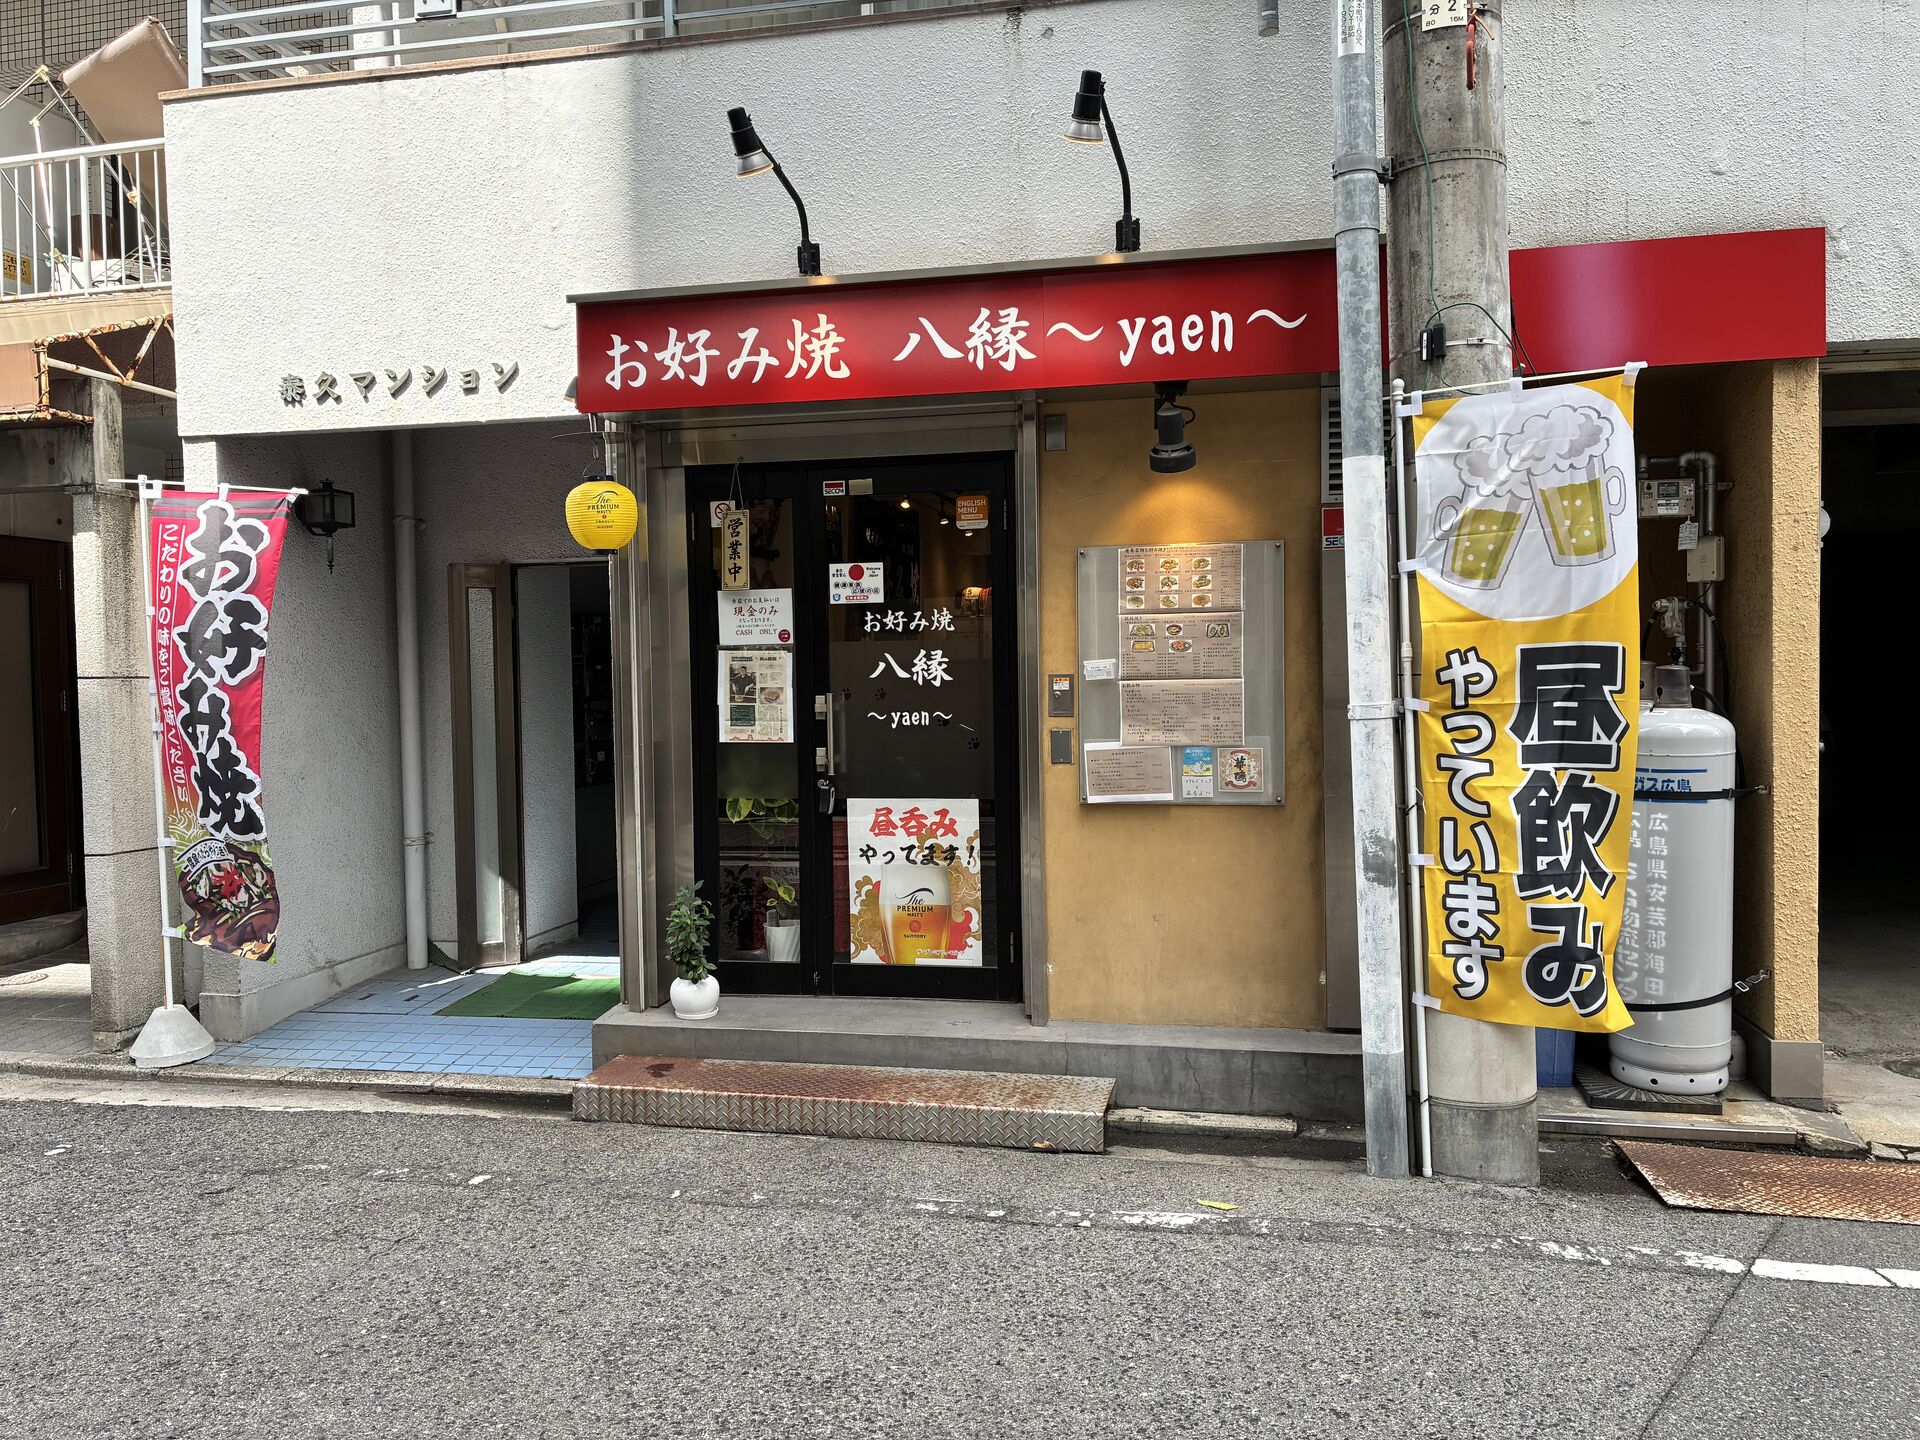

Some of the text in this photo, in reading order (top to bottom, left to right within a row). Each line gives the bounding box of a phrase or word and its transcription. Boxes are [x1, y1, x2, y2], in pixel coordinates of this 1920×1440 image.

[1429, 0, 1458, 16] 分 2
[605, 313, 851, 391] お好み焼
[957, 499, 986, 507] ENGLISH
[727, 518, 743, 583] 営業中
[733, 605, 778, 617] 現金のみ
[864, 607, 955, 632] お好み焼
[173, 499, 270, 840] お好み焼
[869, 649, 954, 688] 八縁
[869, 806, 959, 838] 昼呑み
[1435, 646, 1503, 1000] やっています
[1505, 642, 1629, 1018] 昼飲み
[896, 905, 933, 913] PREMIUM
[905, 894, 926, 905] The
